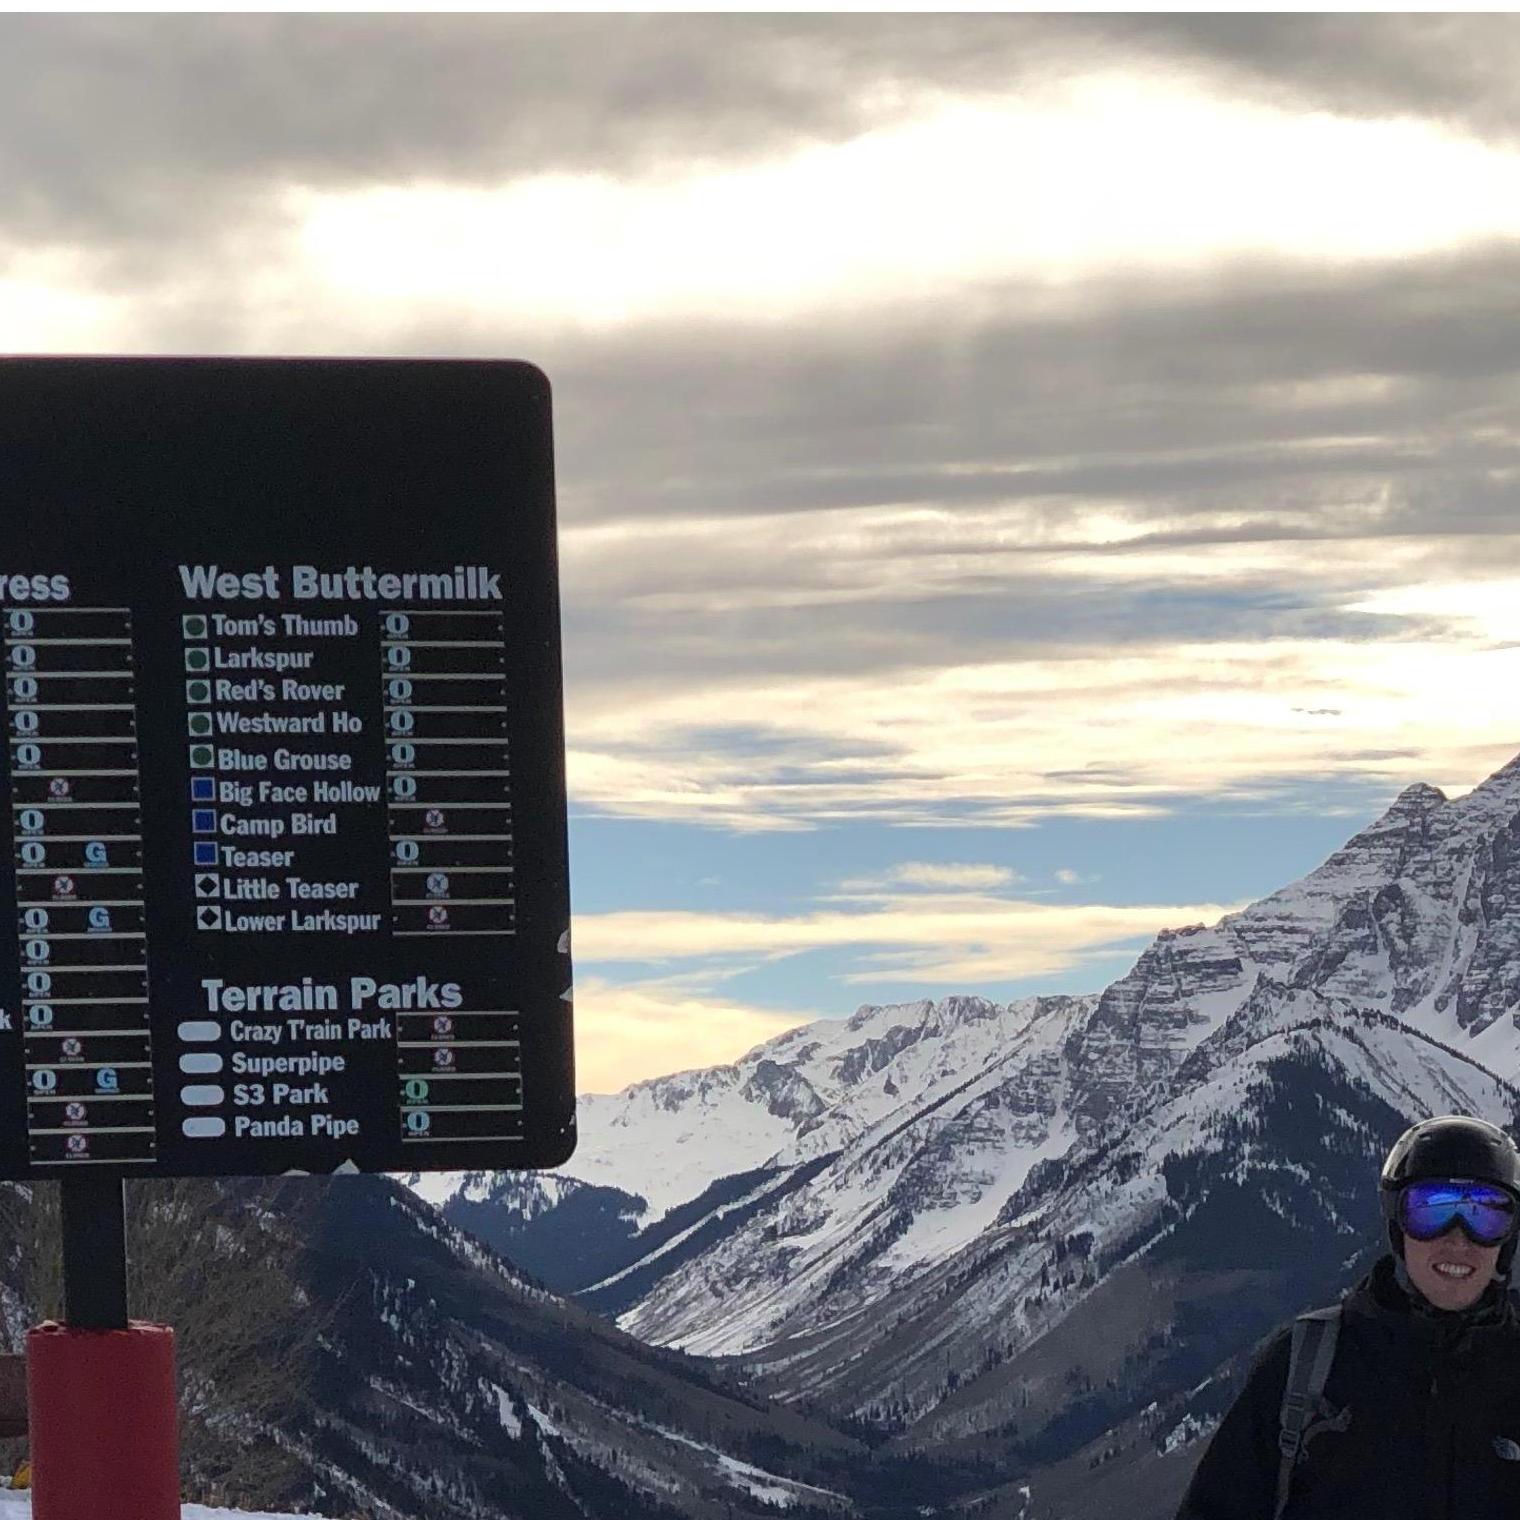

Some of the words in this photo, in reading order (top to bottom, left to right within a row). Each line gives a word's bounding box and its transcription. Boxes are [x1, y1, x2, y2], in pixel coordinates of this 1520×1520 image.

[179, 566, 279, 598] West
[293, 566, 502, 599] Buttermilk
[212, 614, 275, 635] Tom's
[281, 614, 358, 635] Thumb
[215, 647, 313, 671] Larkspur
[216, 679, 275, 700] Red's
[283, 679, 345, 700] Rover
[217, 712, 324, 732] Westward
[333, 712, 362, 732] Ho
[218, 749, 267, 770] Blue
[274, 749, 351, 770] Grouse
[220, 782, 253, 806] Big
[260, 781, 307, 802] Face
[314, 781, 380, 802] Hollow
[221, 814, 284, 838] Camp
[292, 813, 336, 834] Bird
[221, 846, 294, 867] Teaser
[224, 878, 280, 899] Little
[286, 878, 358, 899] Teaser
[225, 911, 285, 931] Lower
[292, 910, 381, 934] Larkspur
[202, 978, 337, 1011] Terrain
[351, 976, 462, 1009] Parks
[231, 1020, 282, 1044] Crazy
[348, 1018, 391, 1039] Park
[232, 1051, 345, 1076] Superpipe
[234, 1084, 265, 1105] S3
[273, 1083, 328, 1104] Park
[235, 1115, 303, 1136] Panda
[311, 1115, 359, 1139] Pipe
